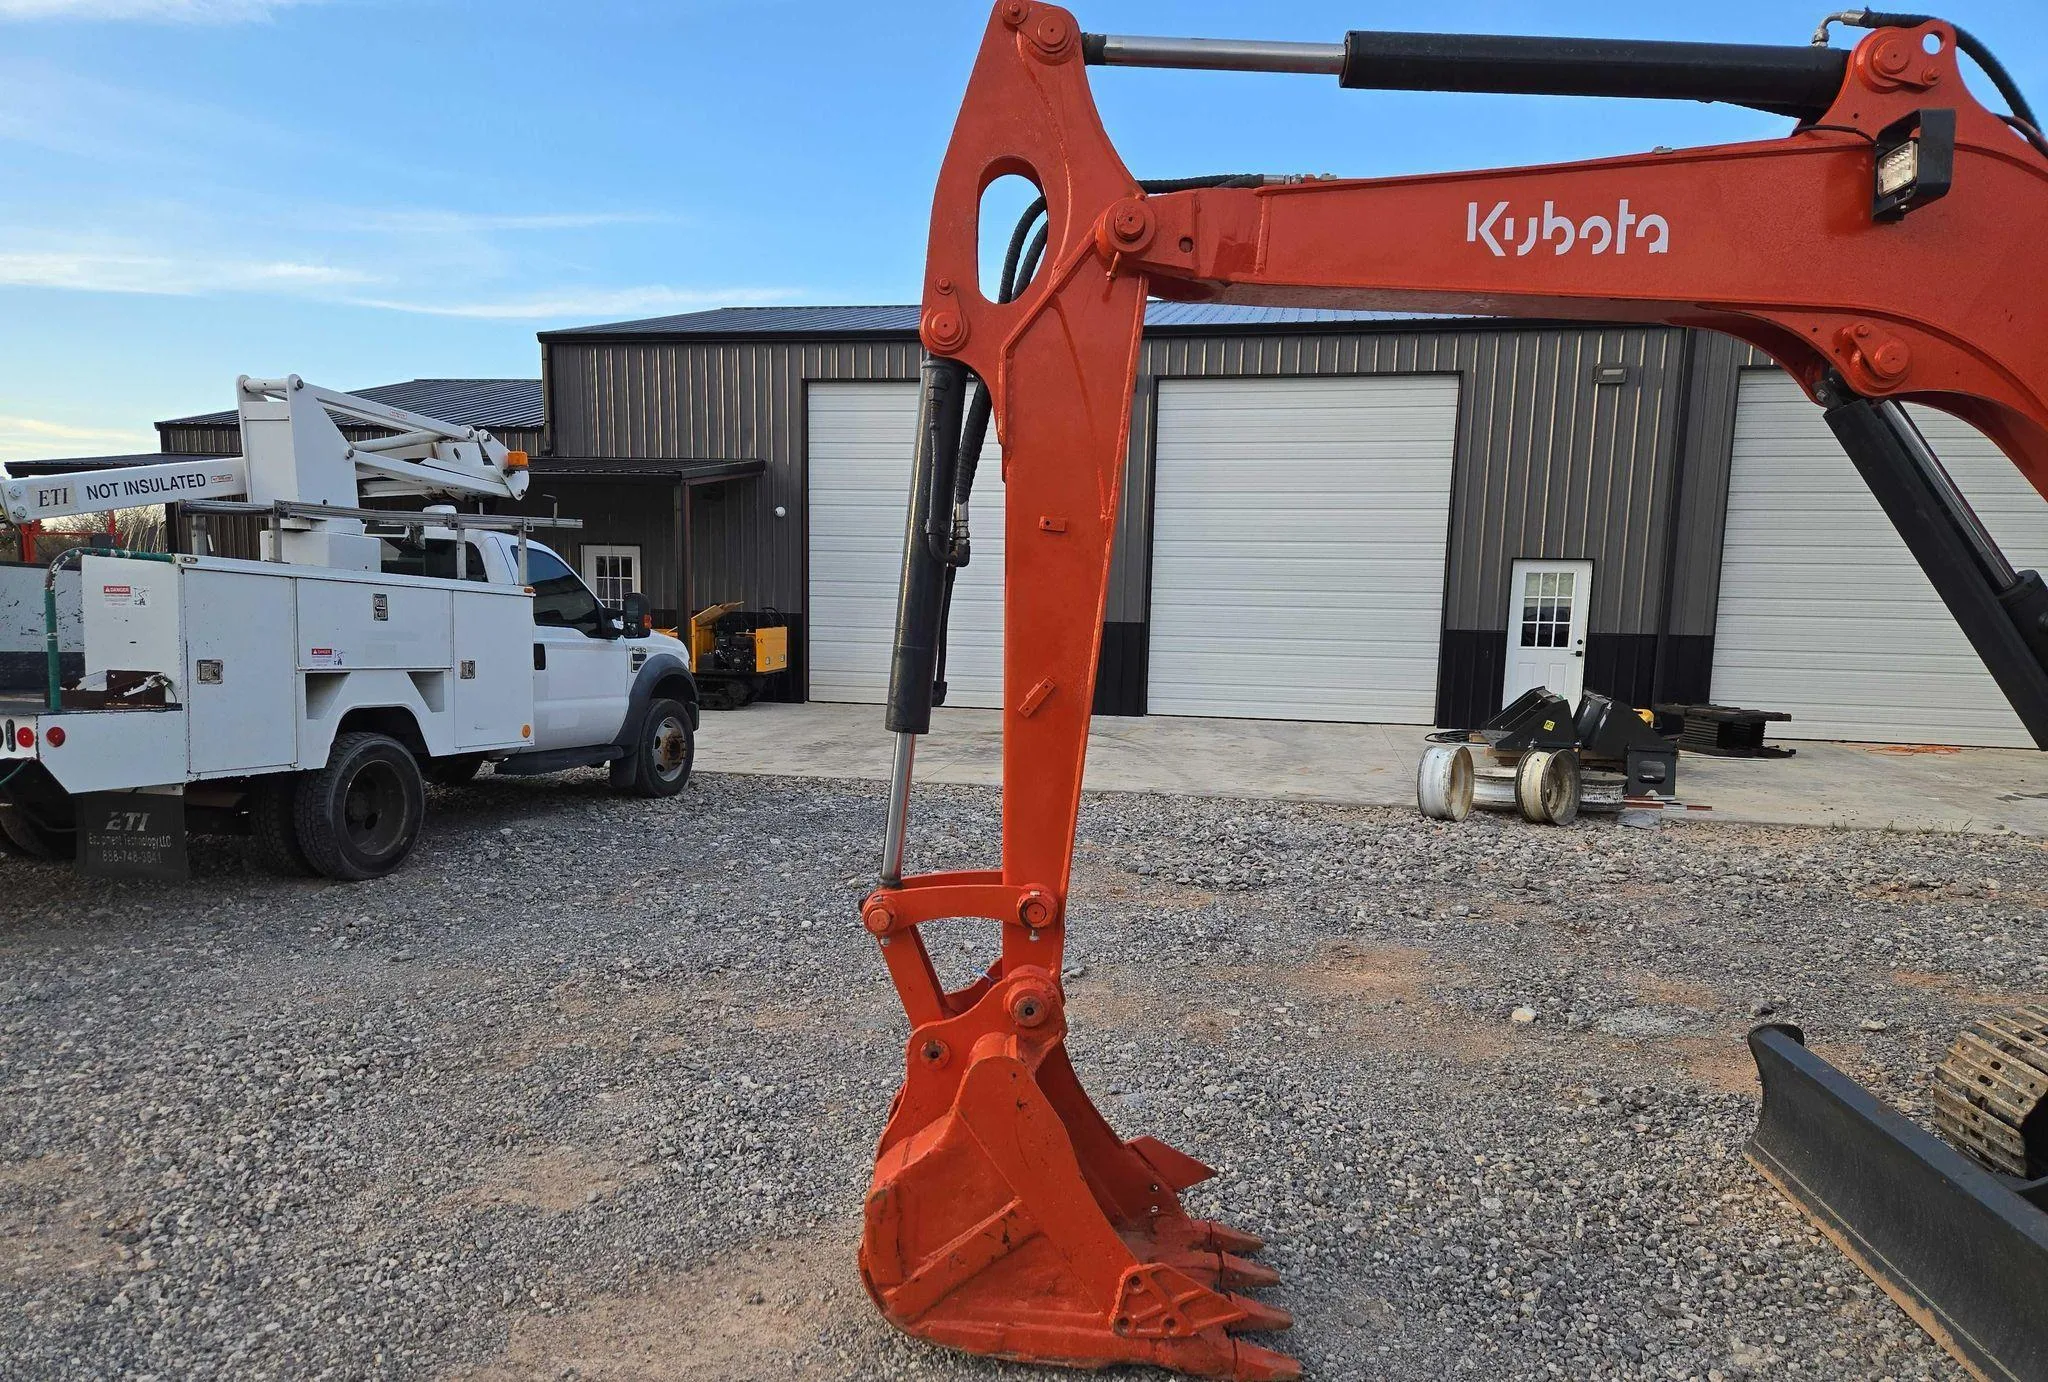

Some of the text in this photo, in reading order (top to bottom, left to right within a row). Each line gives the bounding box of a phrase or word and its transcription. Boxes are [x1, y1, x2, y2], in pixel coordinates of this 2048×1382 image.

[1466, 199, 1670, 257] Kubota
[38, 487, 69, 508] ETI
[86, 482, 120, 501] NOT
[124, 473, 206, 496] INSULATED
